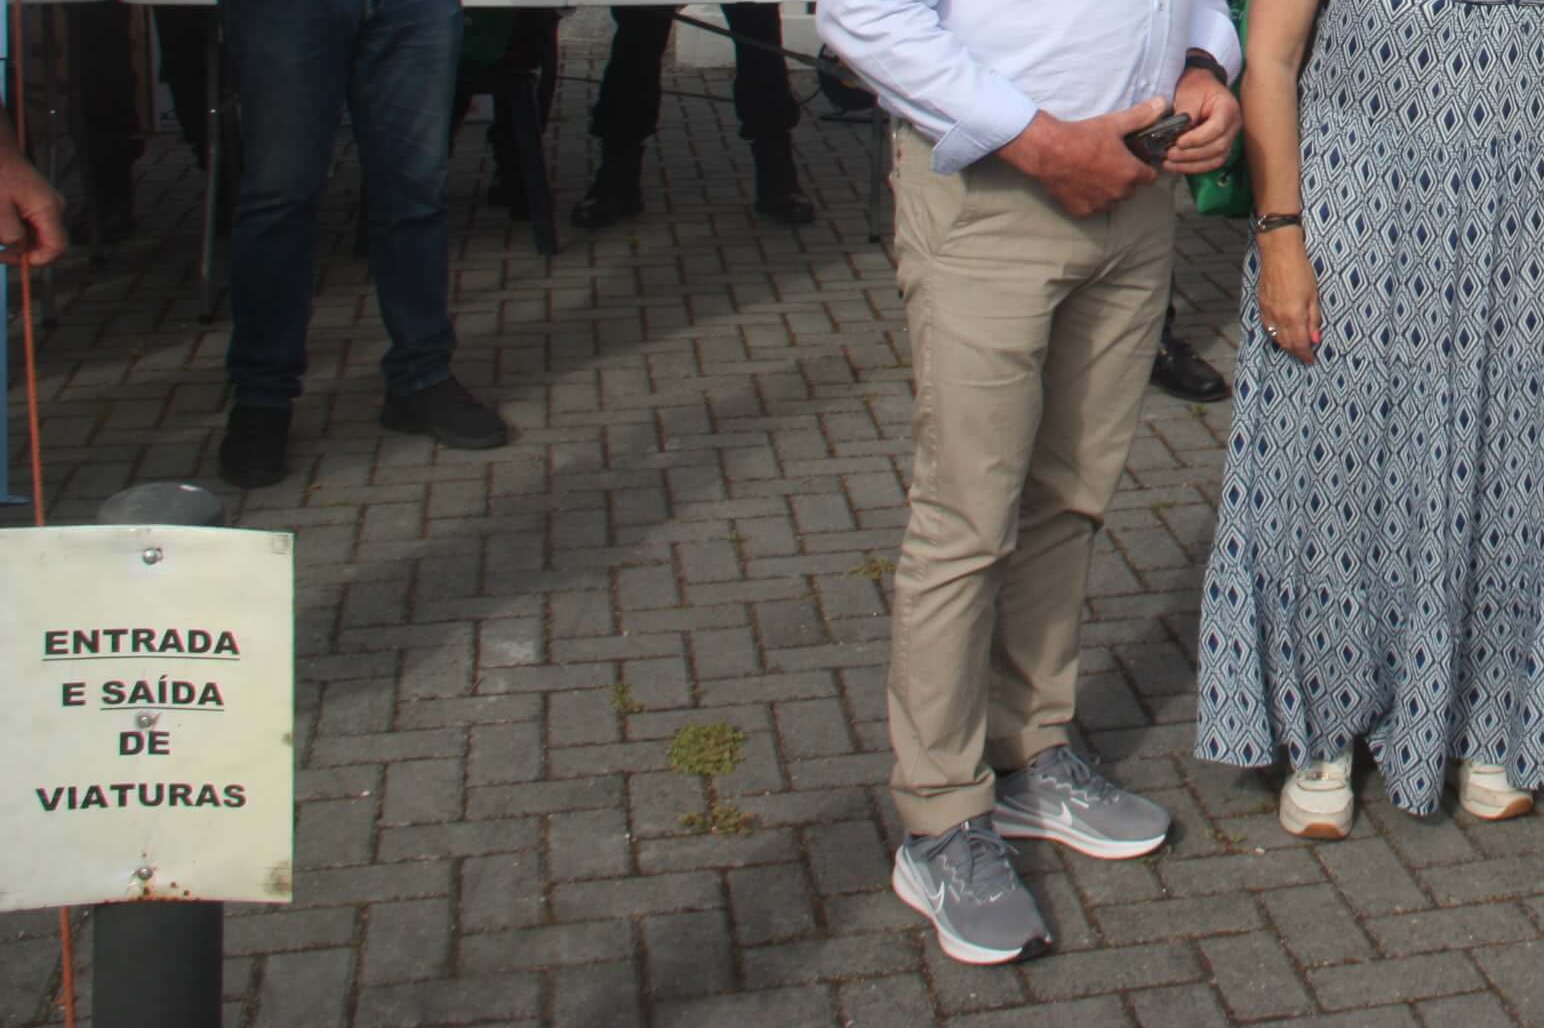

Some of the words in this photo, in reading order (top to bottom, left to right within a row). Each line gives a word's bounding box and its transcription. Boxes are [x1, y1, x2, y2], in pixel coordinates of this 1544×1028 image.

[44, 628, 240, 655] ENTRADA
[62, 682, 86, 707] E
[101, 674, 224, 706] SAÍDA
[118, 730, 171, 756] DE
[36, 783, 247, 812] VIATURAS
